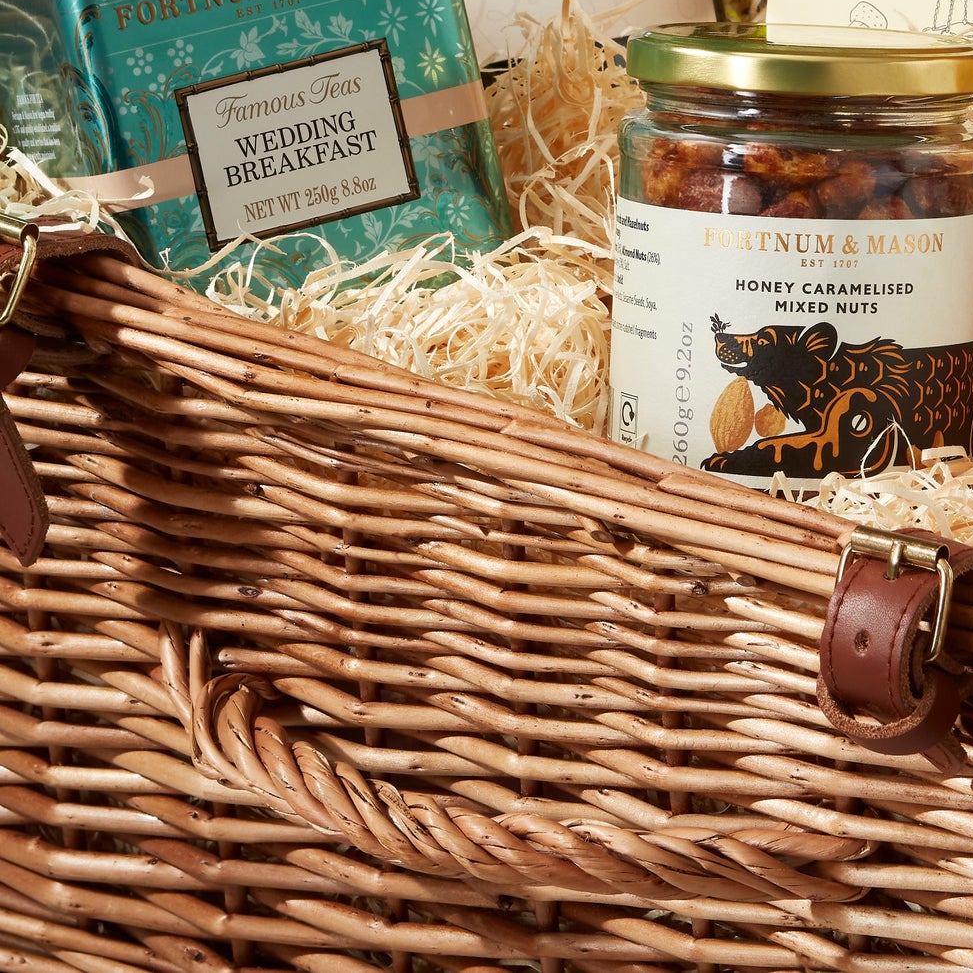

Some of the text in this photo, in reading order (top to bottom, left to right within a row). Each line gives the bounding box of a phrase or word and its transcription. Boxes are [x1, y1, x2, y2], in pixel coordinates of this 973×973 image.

[236, 3, 264, 18] EST
[215, 72, 362, 128] Famous Teas
[234, 110, 357, 160] WEDDING
[223, 130, 377, 187] BREAKFAST
[243, 176, 377, 223] NET WT 250g 8.8oz
[635, 248, 647, 262] Nuts
[703, 227, 945, 255] FORTNUM & MASON
[801, 258, 859, 269] EST 1707
[735, 279, 914, 295] HONEY CARAMELISED
[775, 300, 879, 314] MIXED NUTS
[635, 324, 657, 340] fragments
[676, 322, 694, 381] 9.2oz
[672, 406, 694, 465] 260g
